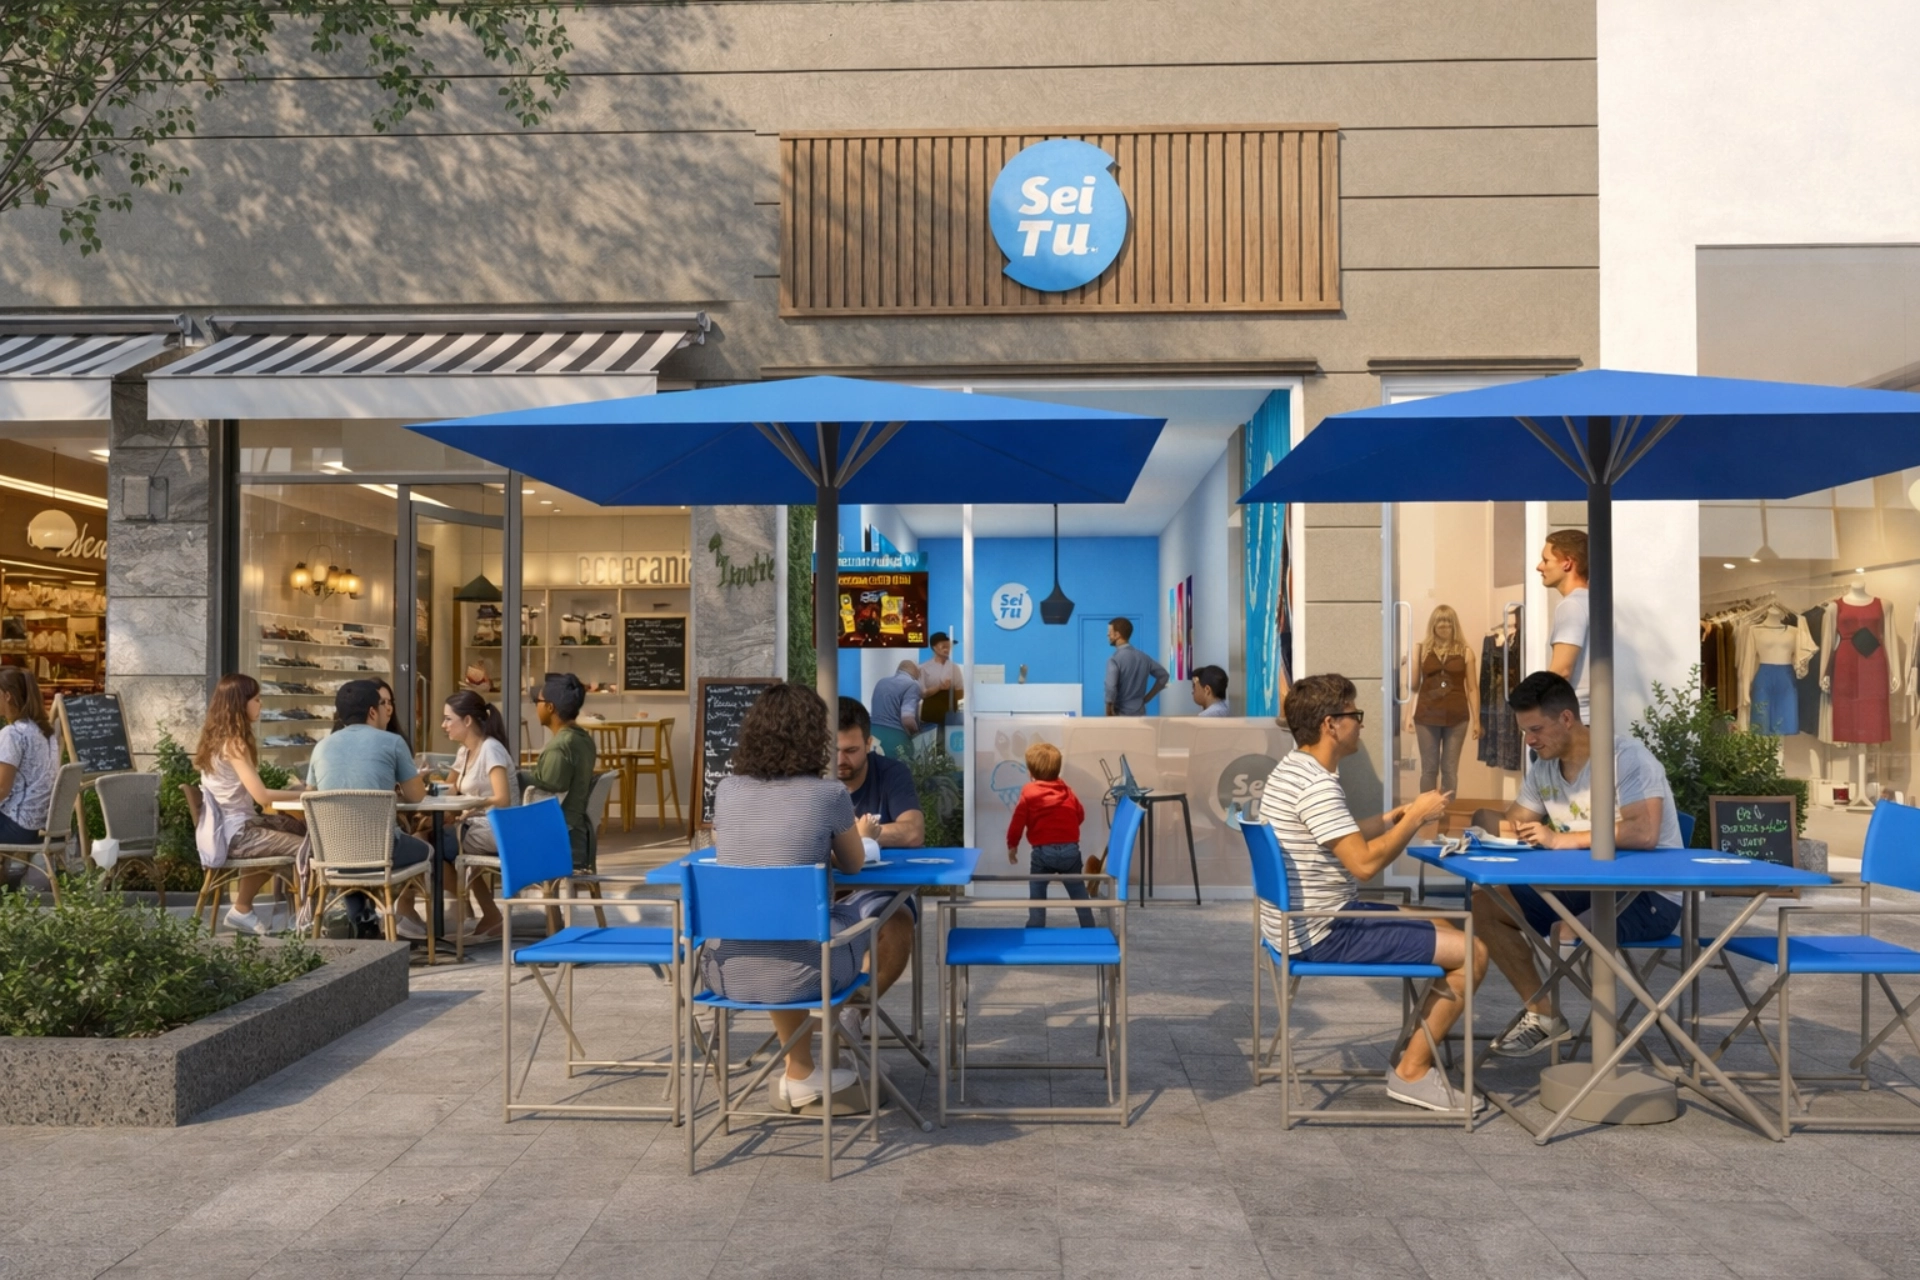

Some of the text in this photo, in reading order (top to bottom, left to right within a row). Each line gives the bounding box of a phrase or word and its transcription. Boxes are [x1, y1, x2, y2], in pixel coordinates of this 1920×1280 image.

[1018, 175, 1096, 215] Sei
[1017, 220, 1091, 256] Tu
[1000, 593, 1024, 606] Sei
[1000, 607, 1021, 619] Tu
[1232, 774, 1267, 798] Se
